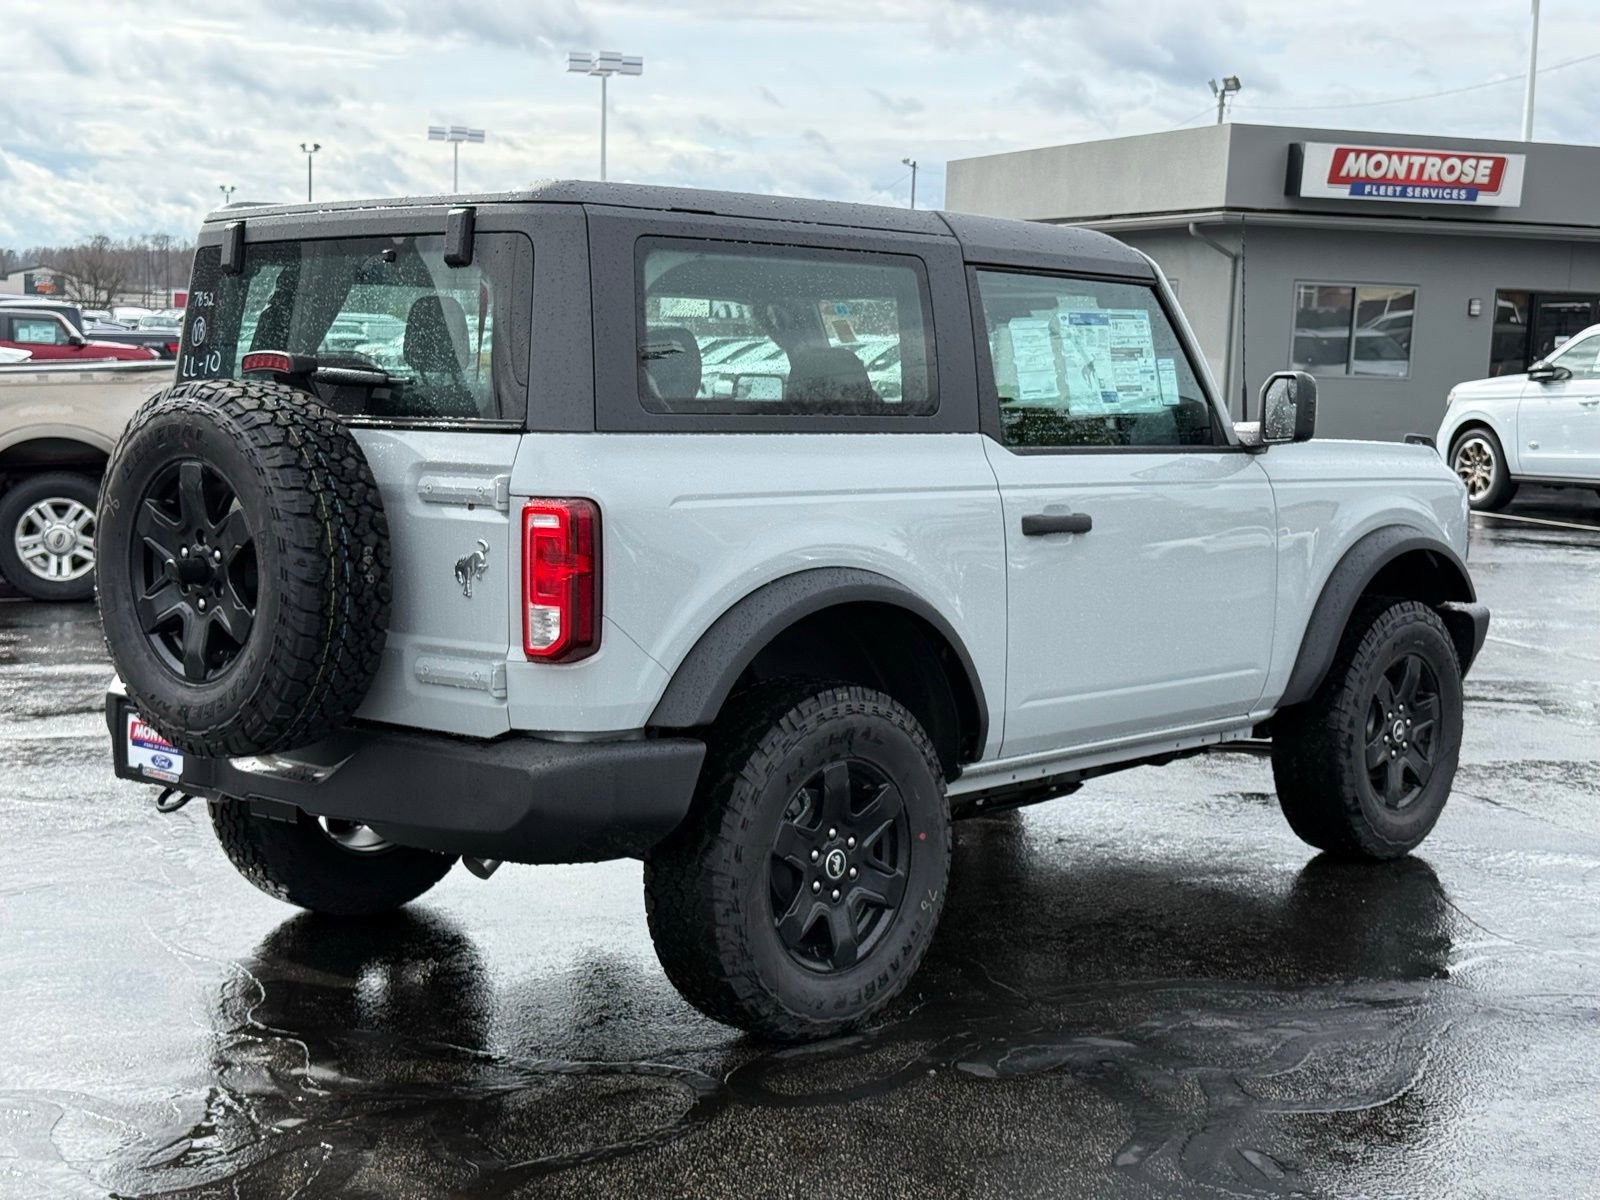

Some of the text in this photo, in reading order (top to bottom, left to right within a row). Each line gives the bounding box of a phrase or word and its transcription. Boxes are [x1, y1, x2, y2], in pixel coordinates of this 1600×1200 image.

[1340, 152, 1495, 185] MONTROSE
[1364, 184, 1467, 199] FLEET SERVICES
